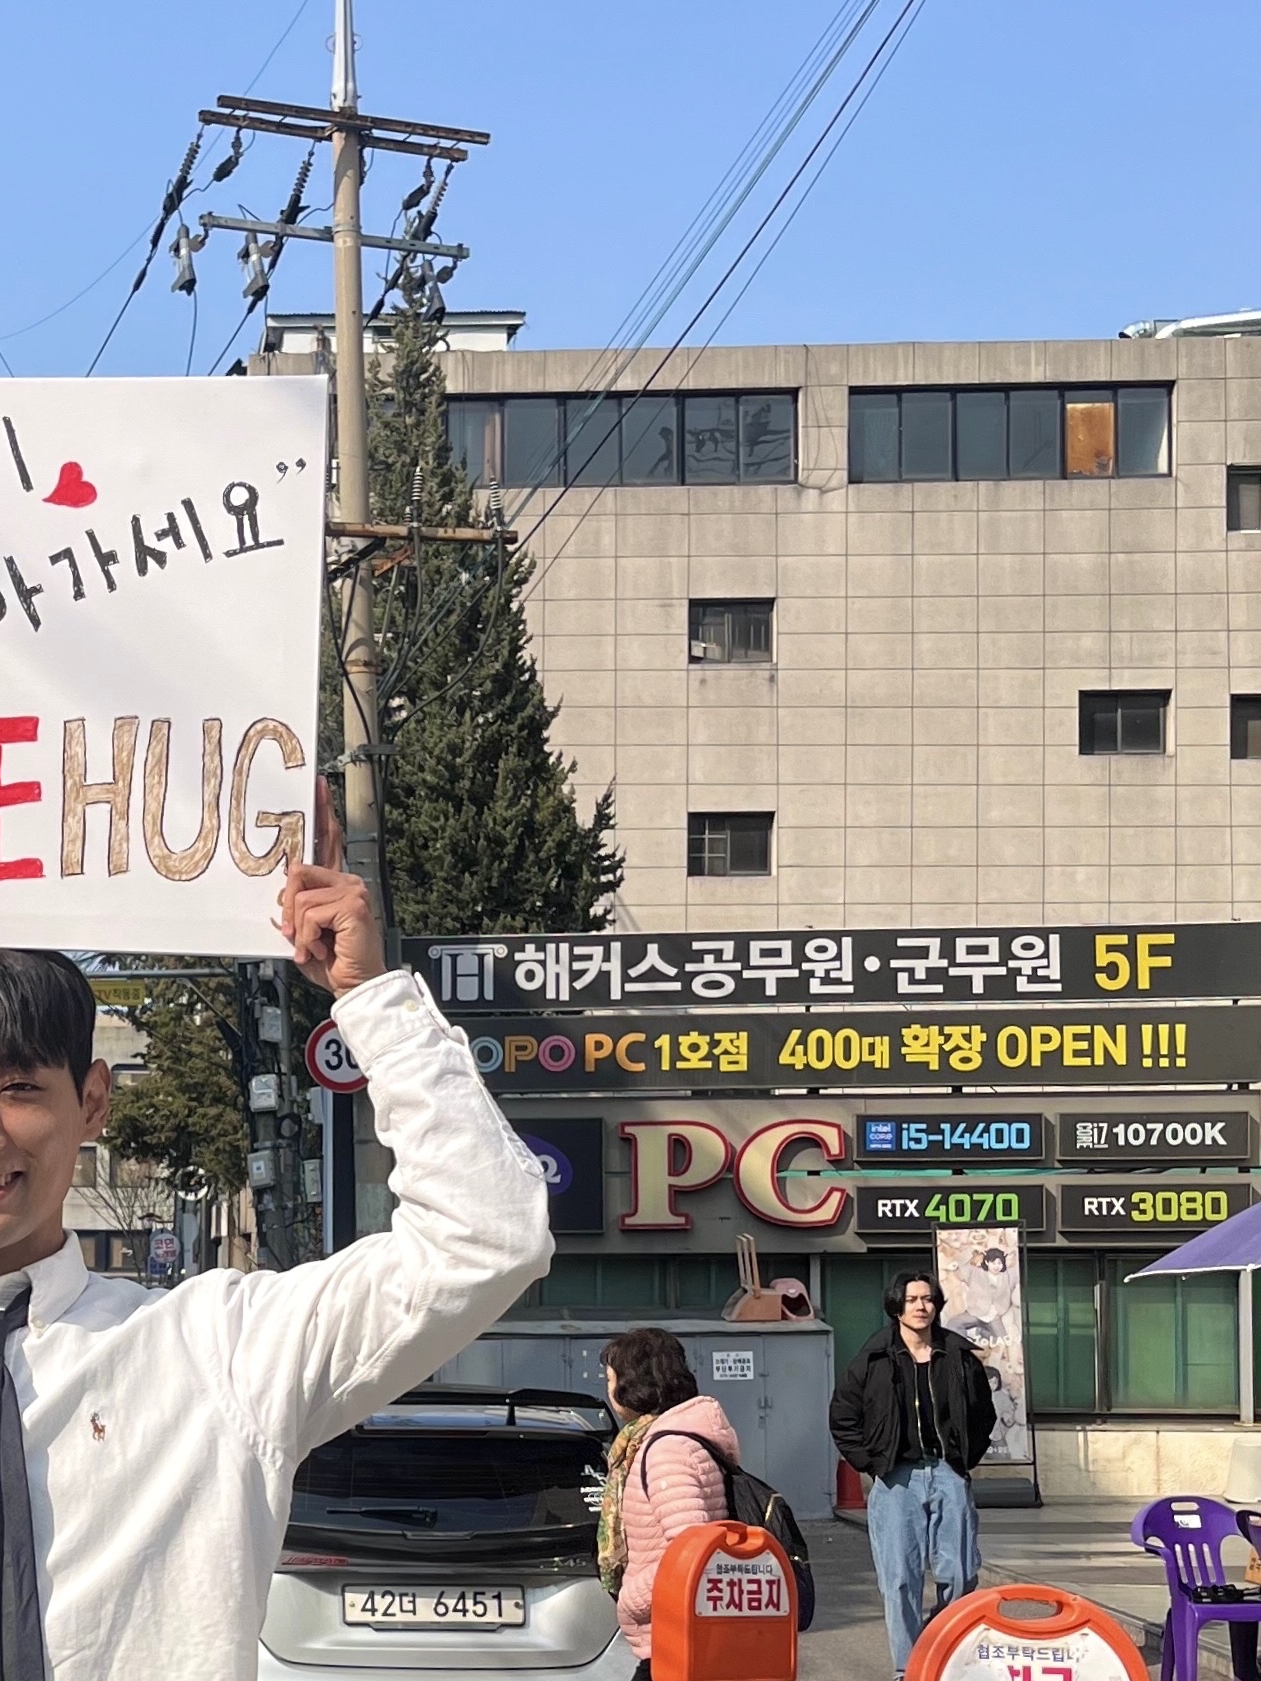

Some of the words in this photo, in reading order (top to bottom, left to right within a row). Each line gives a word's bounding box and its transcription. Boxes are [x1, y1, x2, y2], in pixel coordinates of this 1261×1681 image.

[59, 715, 307, 882] HUG
[1093, 932, 1176, 992] 5F
[472, 1034, 576, 1073] OPO
[584, 1032, 647, 1072] PC
[653, 1030, 750, 1073] 1호점
[778, 1027, 890, 1071] 400대
[900, 1023, 988, 1071] 확장
[996, 1024, 1128, 1068] OPEN
[901, 1121, 1031, 1151] i5-14400
[1112, 1121, 1228, 1147] 10700K
[619, 1118, 847, 1232] PC
[877, 1199, 920, 1218] RTX
[924, 1192, 1020, 1223] 4070
[1084, 1197, 1126, 1216] RTX
[1130, 1190, 1229, 1222] 3080
[360, 1589, 417, 1618] 42더
[433, 1590, 504, 1618] 6451
[705, 1577, 781, 1612] 주차금지
